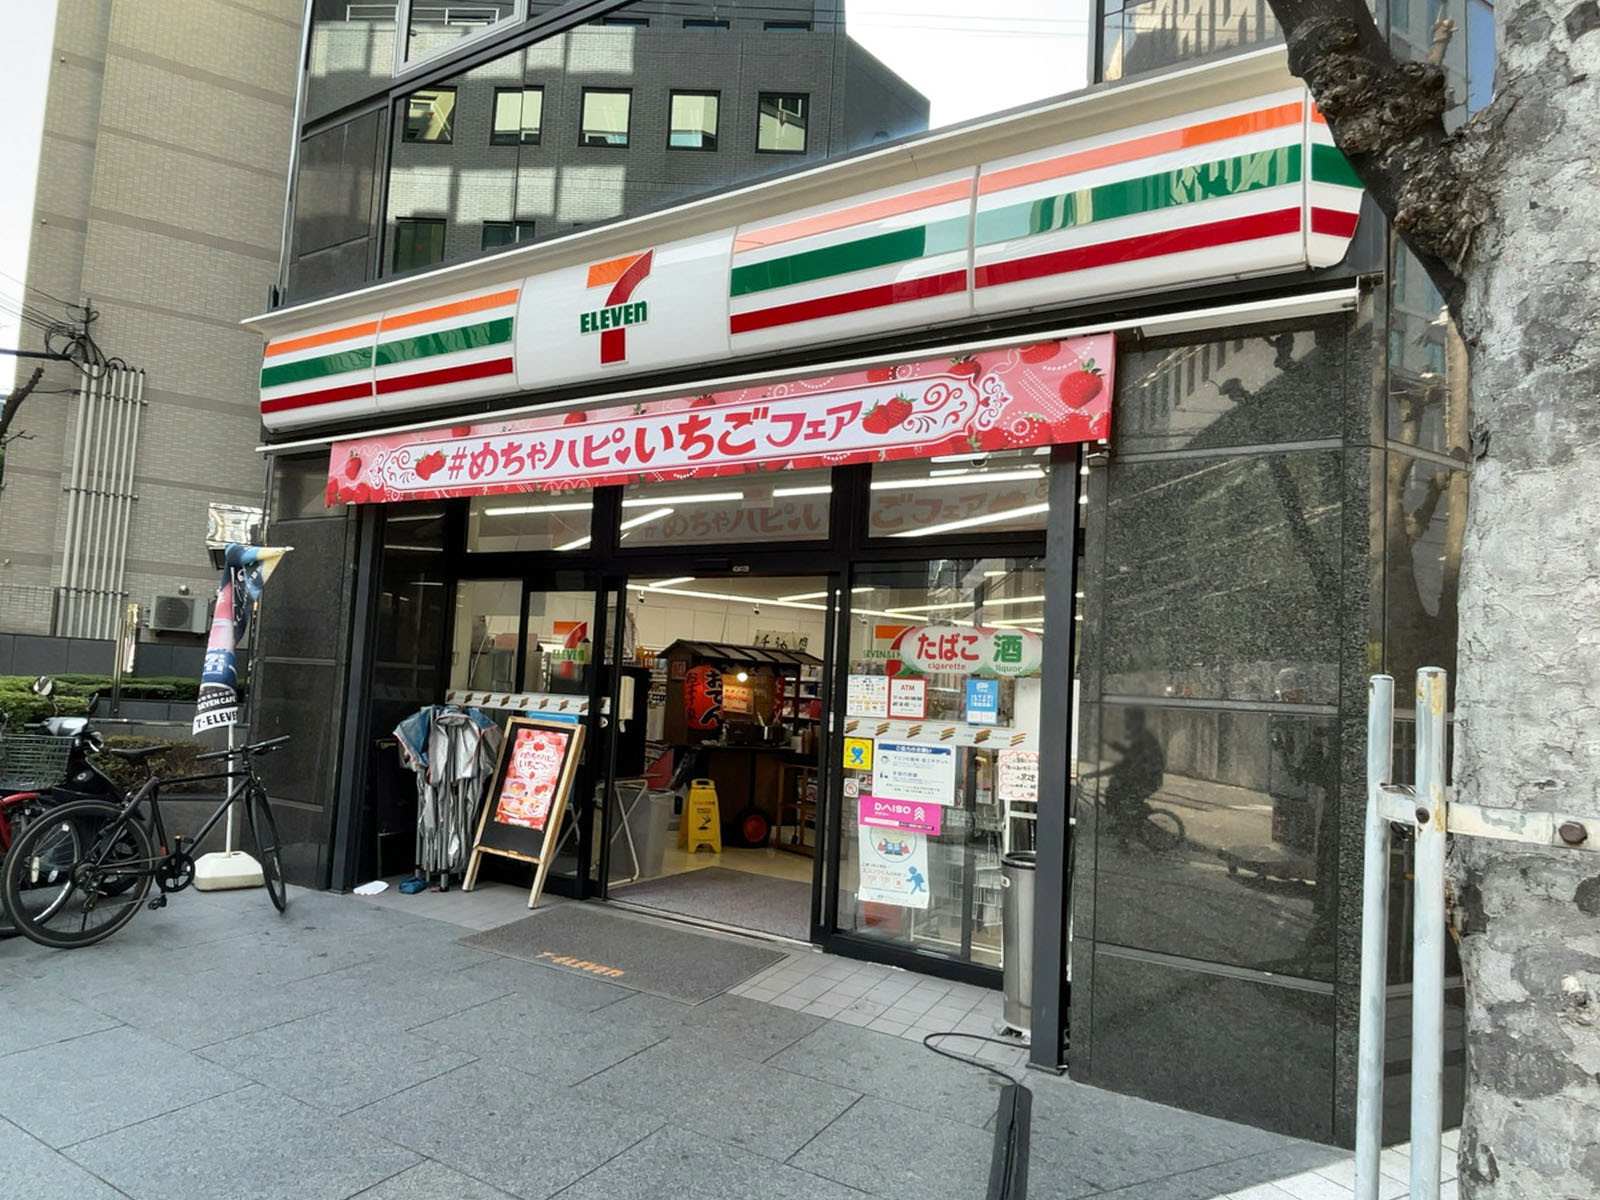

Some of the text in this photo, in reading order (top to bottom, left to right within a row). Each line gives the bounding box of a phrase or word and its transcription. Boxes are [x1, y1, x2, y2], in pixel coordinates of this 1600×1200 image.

[586, 249, 653, 364] 7
[917, 633, 1023, 663] たばこ 酒
[928, 662, 1023, 673] cigarette liquor
[196, 711, 238, 729] 7-ELEVE
[874, 802, 911, 815] DAISO
